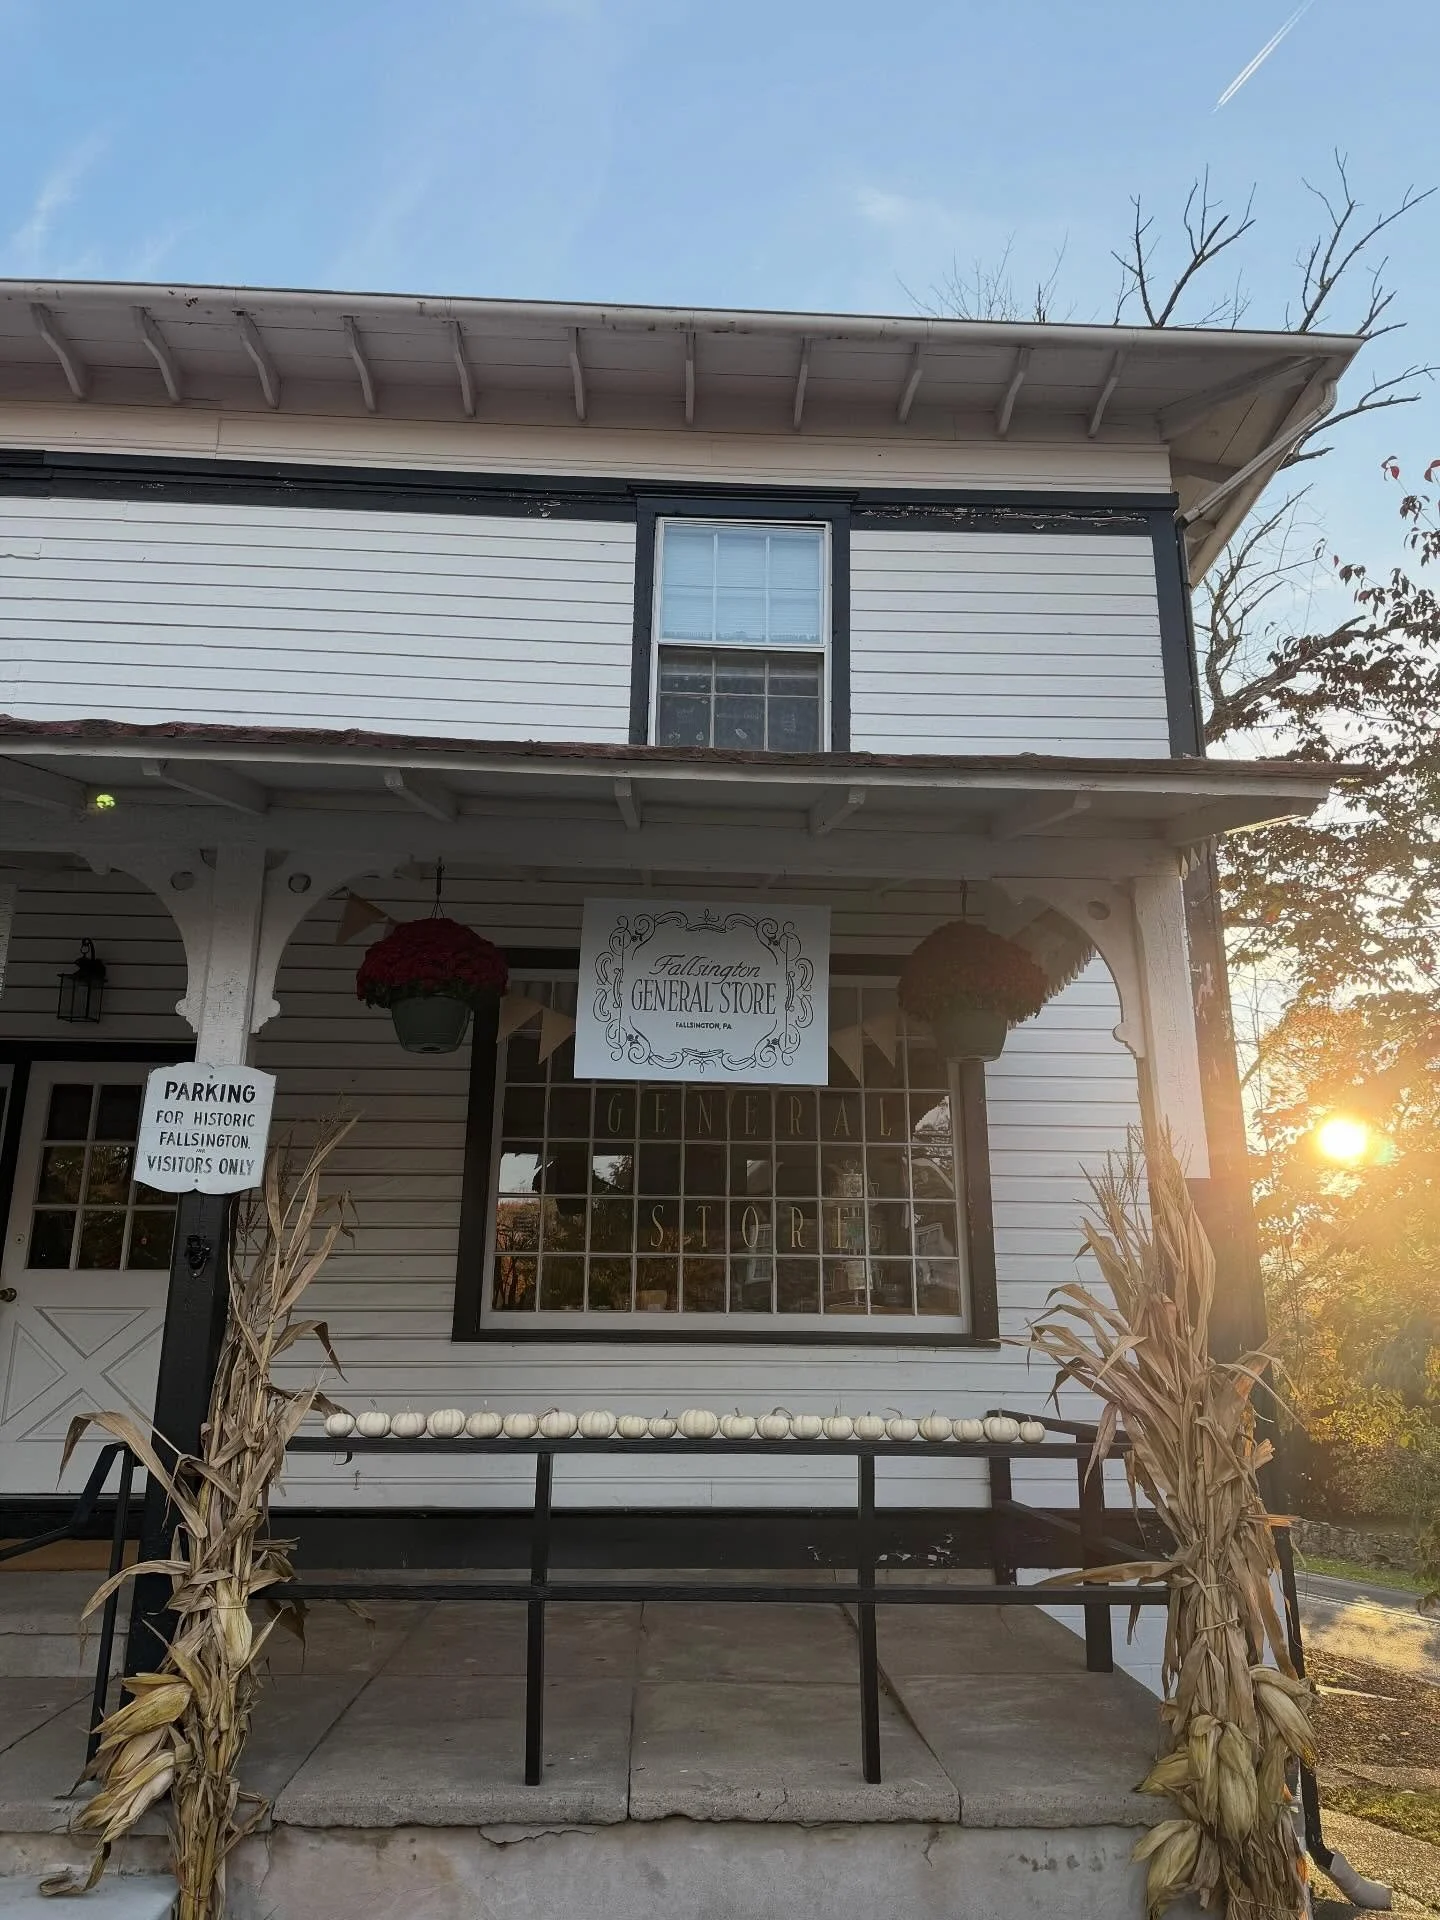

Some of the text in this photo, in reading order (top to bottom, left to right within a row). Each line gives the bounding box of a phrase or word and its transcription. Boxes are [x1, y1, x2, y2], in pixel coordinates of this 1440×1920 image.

[649, 953, 761, 984] Fallsington
[631, 978, 776, 1015] GENERAL STORE
[722, 1022, 732, 1030] PA
[164, 1081, 256, 1103] PARKING
[156, 1110, 256, 1128] FOR HISTORIC
[606, 1092, 894, 1136] GENERAL
[146, 1155, 255, 1176] VISITORS ONLY
[649, 1203, 850, 1249] STORE
